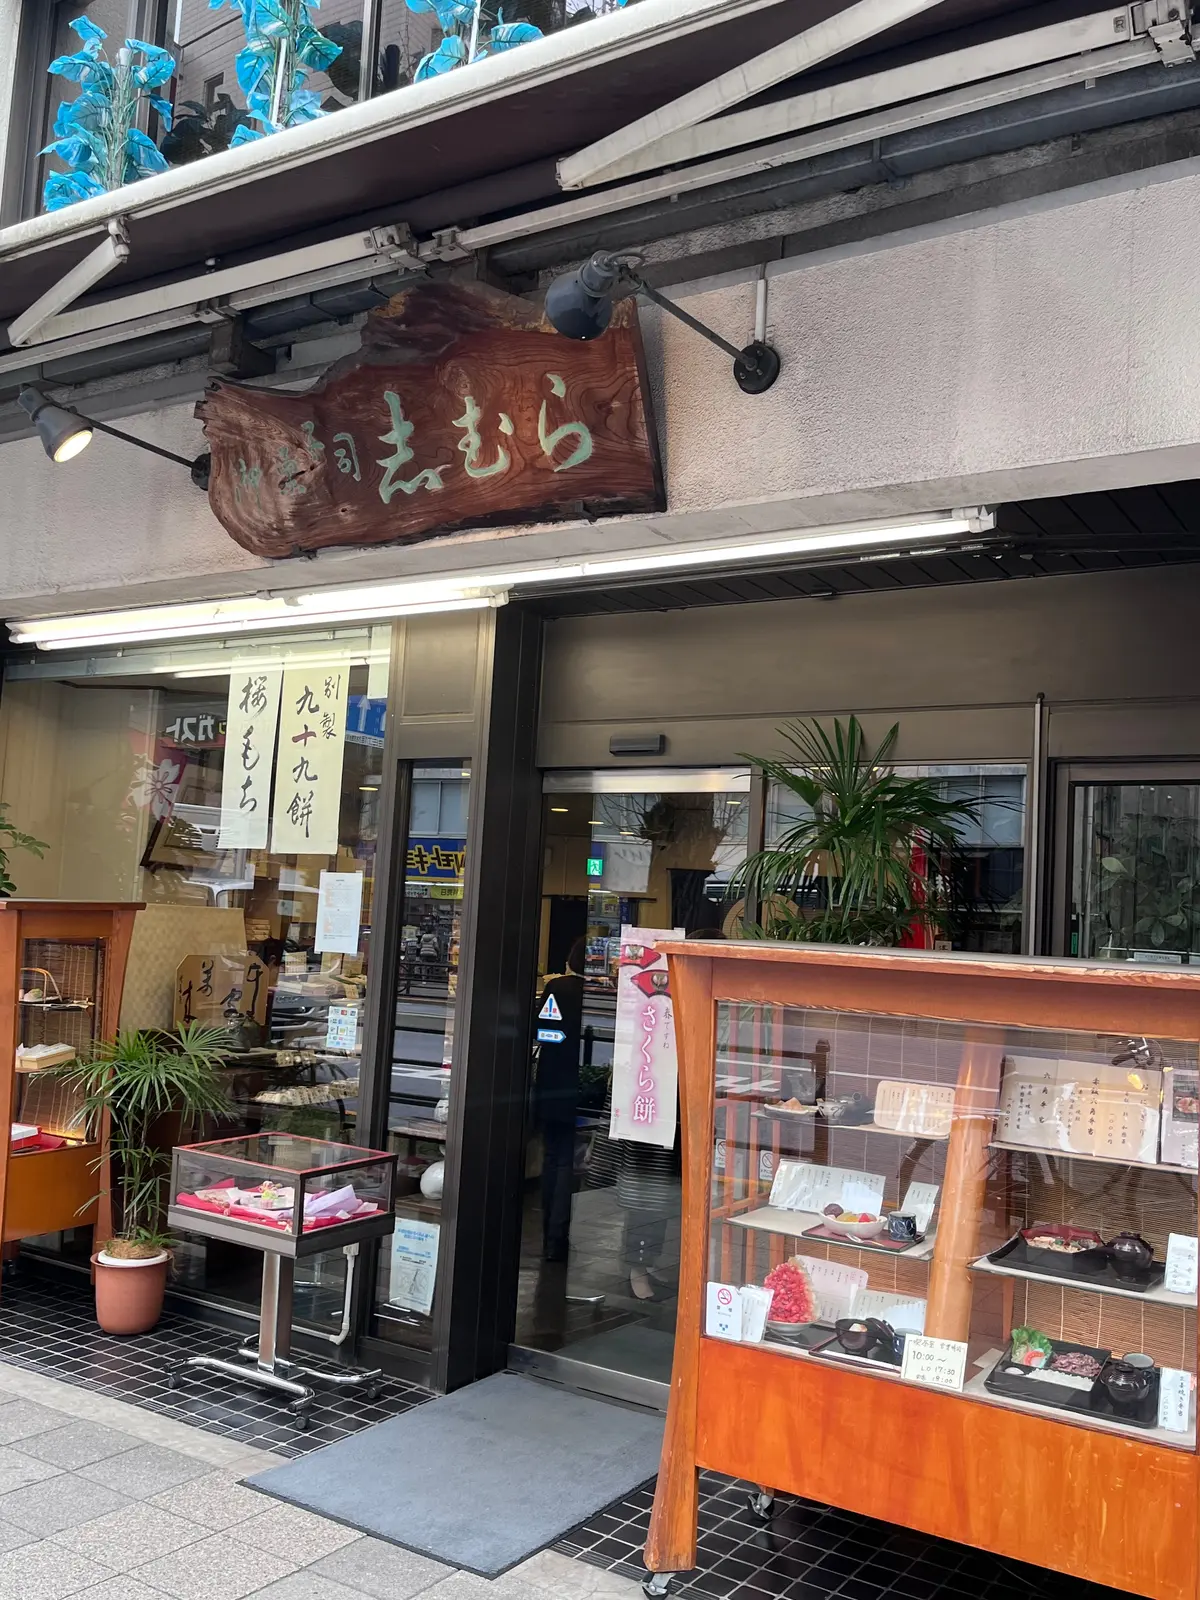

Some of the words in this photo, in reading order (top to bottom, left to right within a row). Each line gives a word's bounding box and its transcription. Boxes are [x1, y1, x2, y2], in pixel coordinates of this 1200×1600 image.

[286, 685, 320, 838] 九十九餅
[319, 674, 341, 740] 別製
[632, 1005, 658, 1124] さくら餅
